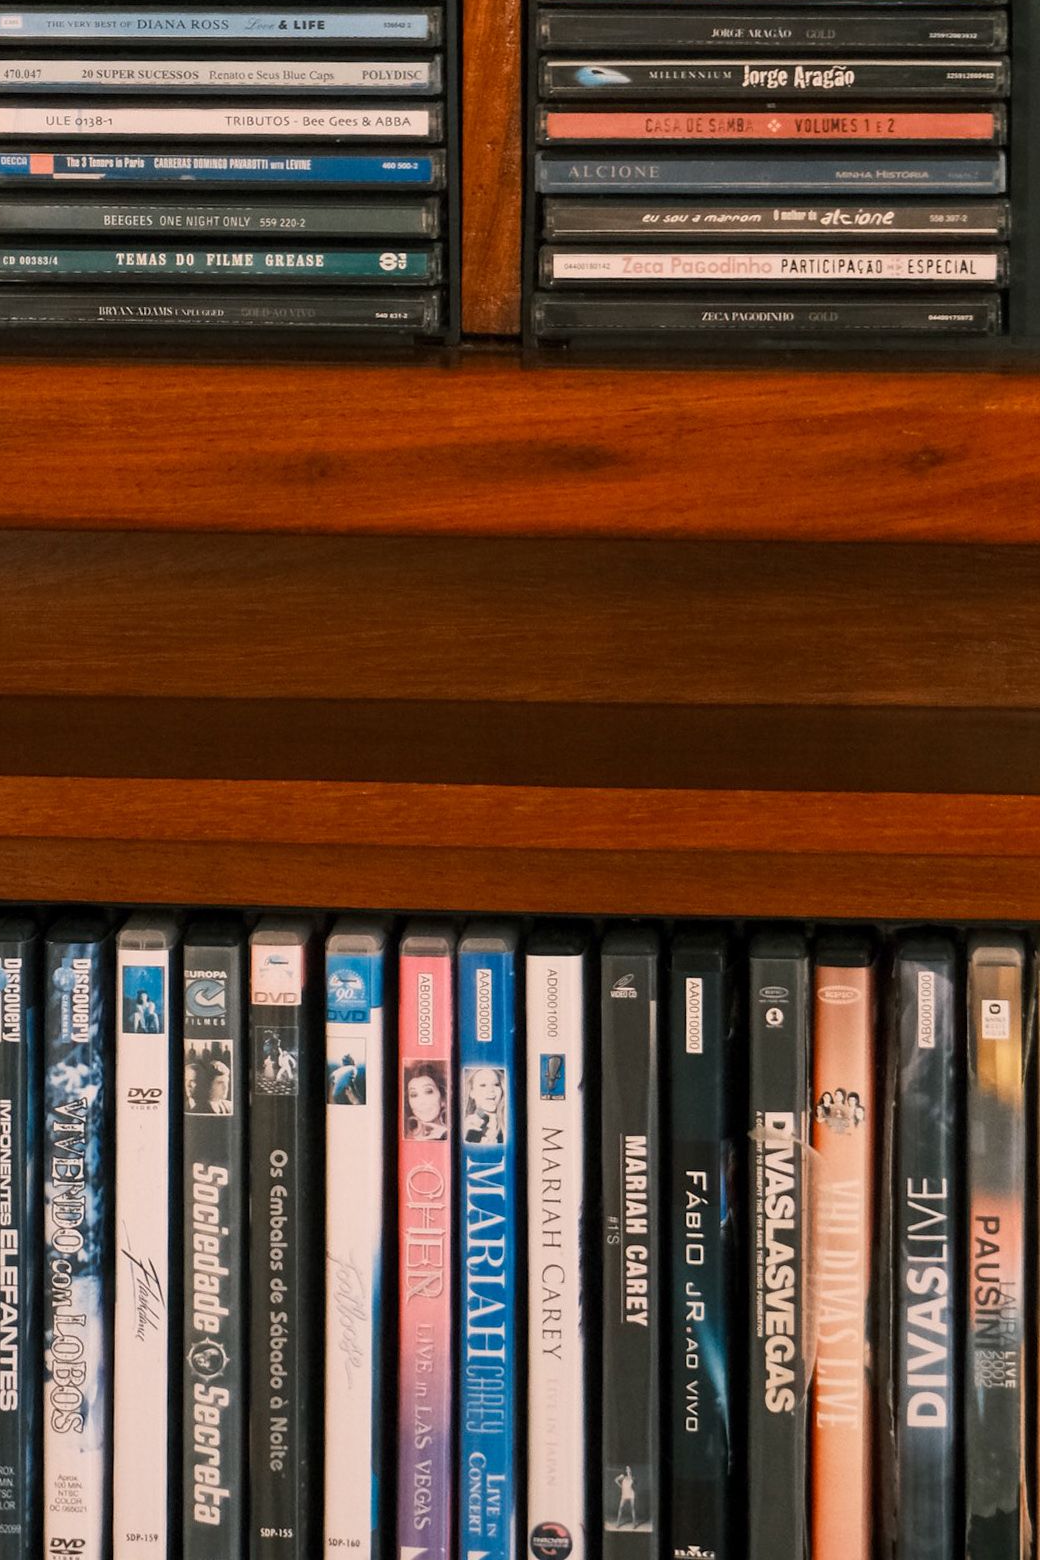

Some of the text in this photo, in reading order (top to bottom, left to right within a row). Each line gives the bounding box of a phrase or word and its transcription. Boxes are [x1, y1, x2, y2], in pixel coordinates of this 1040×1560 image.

[742, 65, 854, 88] Jorge Aragão
[569, 166, 659, 179] ALCIONE
[116, 253, 324, 268] TEMAS DO FILME GREASE
[781, 260, 976, 275] PARTICIPAÇÃO ESPECIAL
[625, 1136, 648, 1326] MARIAH CAREY
[685, 1169, 708, 1265] FÁBIO
[0, 1229, 18, 1411] ELEFANTES
[192, 1163, 229, 1525] Sociedade Secreta
[270, 1149, 288, 1472] Os Embalos de Sábado à Noite
[907, 1178, 948, 1428] DIVASLIVE
